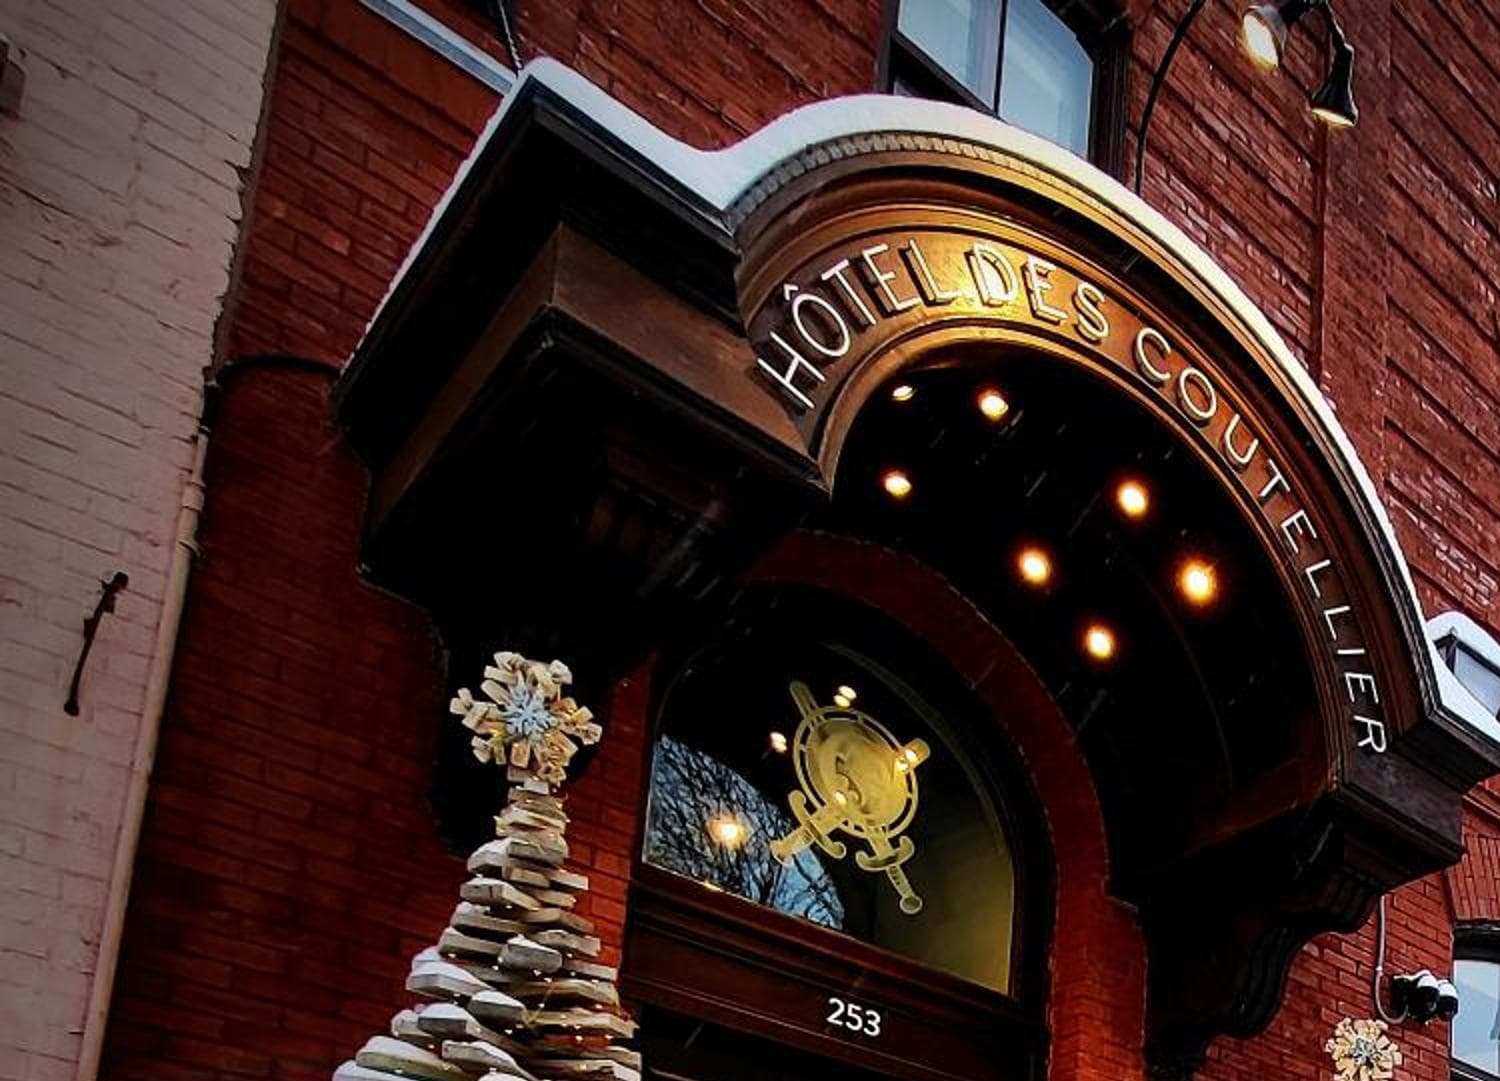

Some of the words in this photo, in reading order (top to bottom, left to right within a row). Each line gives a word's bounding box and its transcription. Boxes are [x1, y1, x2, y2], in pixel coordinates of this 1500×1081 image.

[757, 238, 960, 410] HÔTEL
[970, 240, 1111, 340] DES
[1135, 327, 1387, 754] COUTELLIER
[826, 997, 882, 1037] 253
